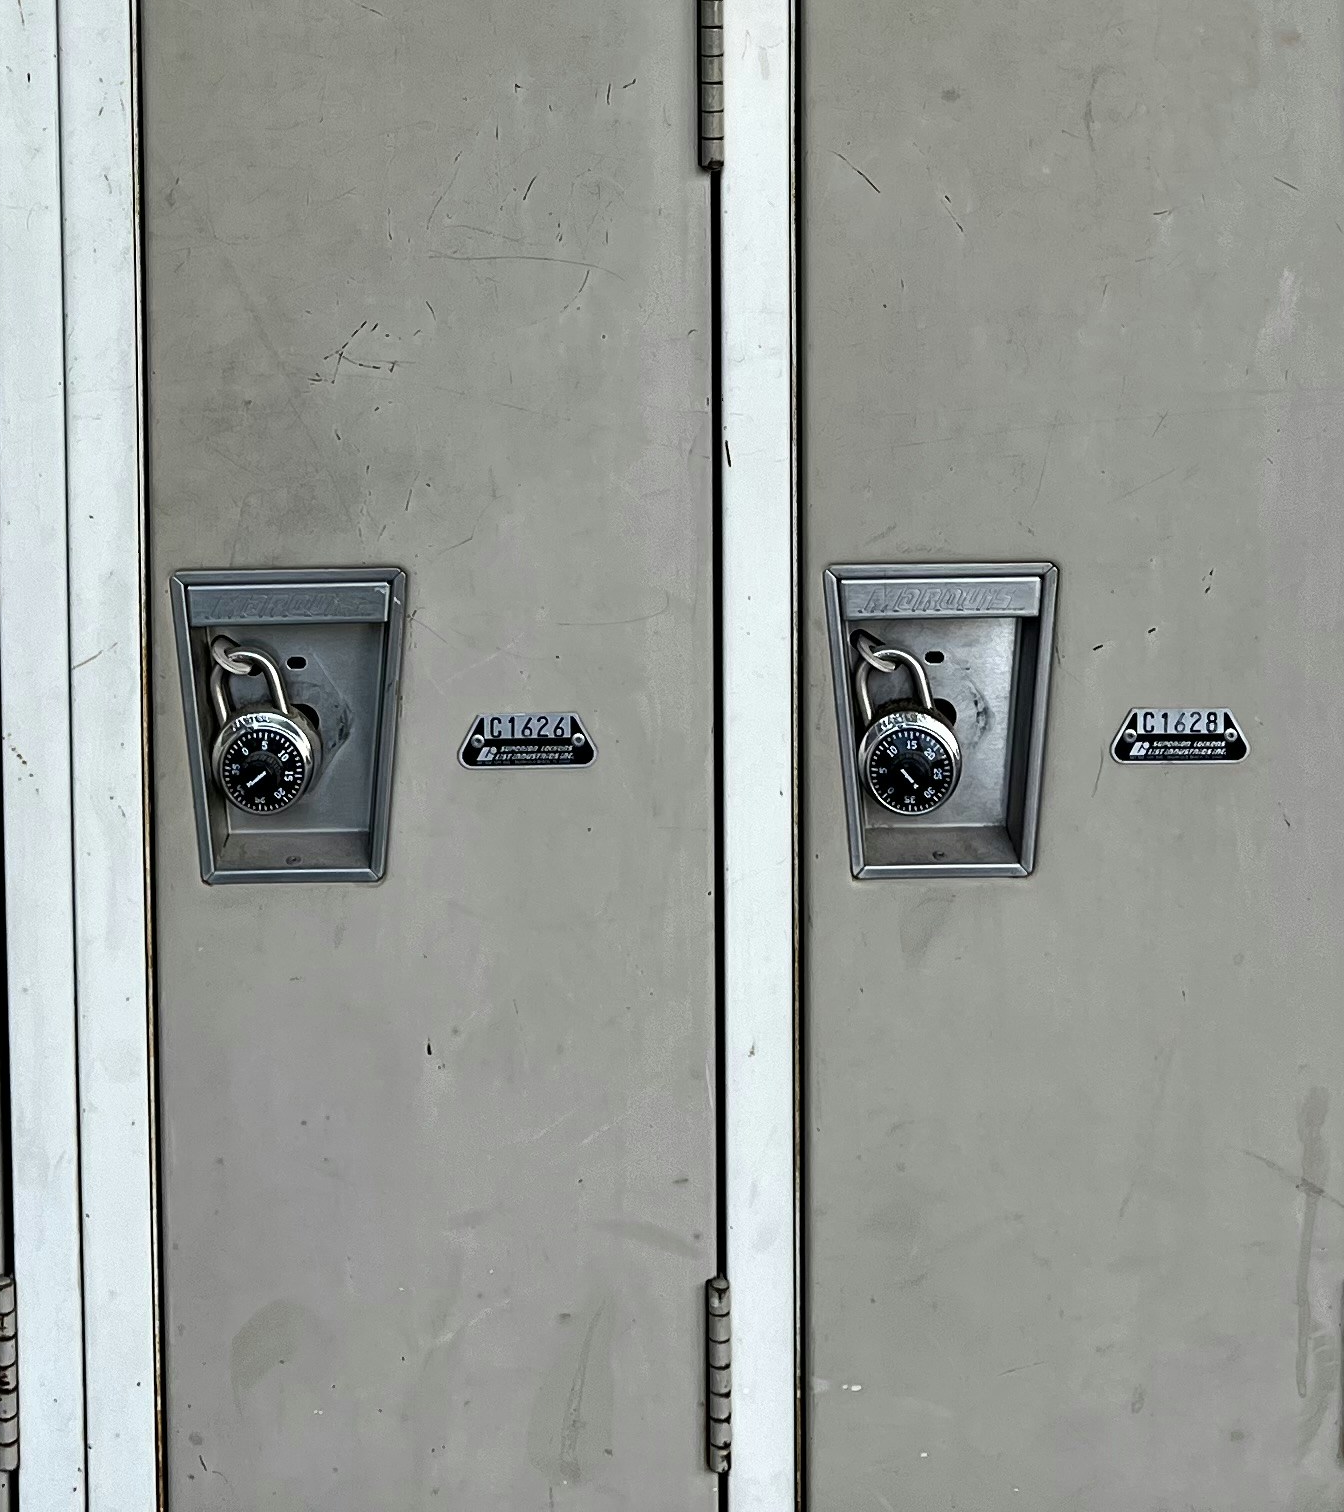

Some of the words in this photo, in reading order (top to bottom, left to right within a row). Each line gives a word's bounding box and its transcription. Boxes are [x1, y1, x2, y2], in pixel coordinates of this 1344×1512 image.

[490, 716, 564, 738] C1626
[1143, 712, 1217, 733] C1628
[262, 740, 268, 749] 5
[907, 740, 917, 750] 15
[278, 750, 289, 761] 10
[886, 746, 898, 757] 10
[924, 748, 935, 760] 20
[284, 771, 294, 781] 15
[933, 768, 942, 779] 25
[274, 788, 286, 798] 20
[923, 787, 935, 798] 30
